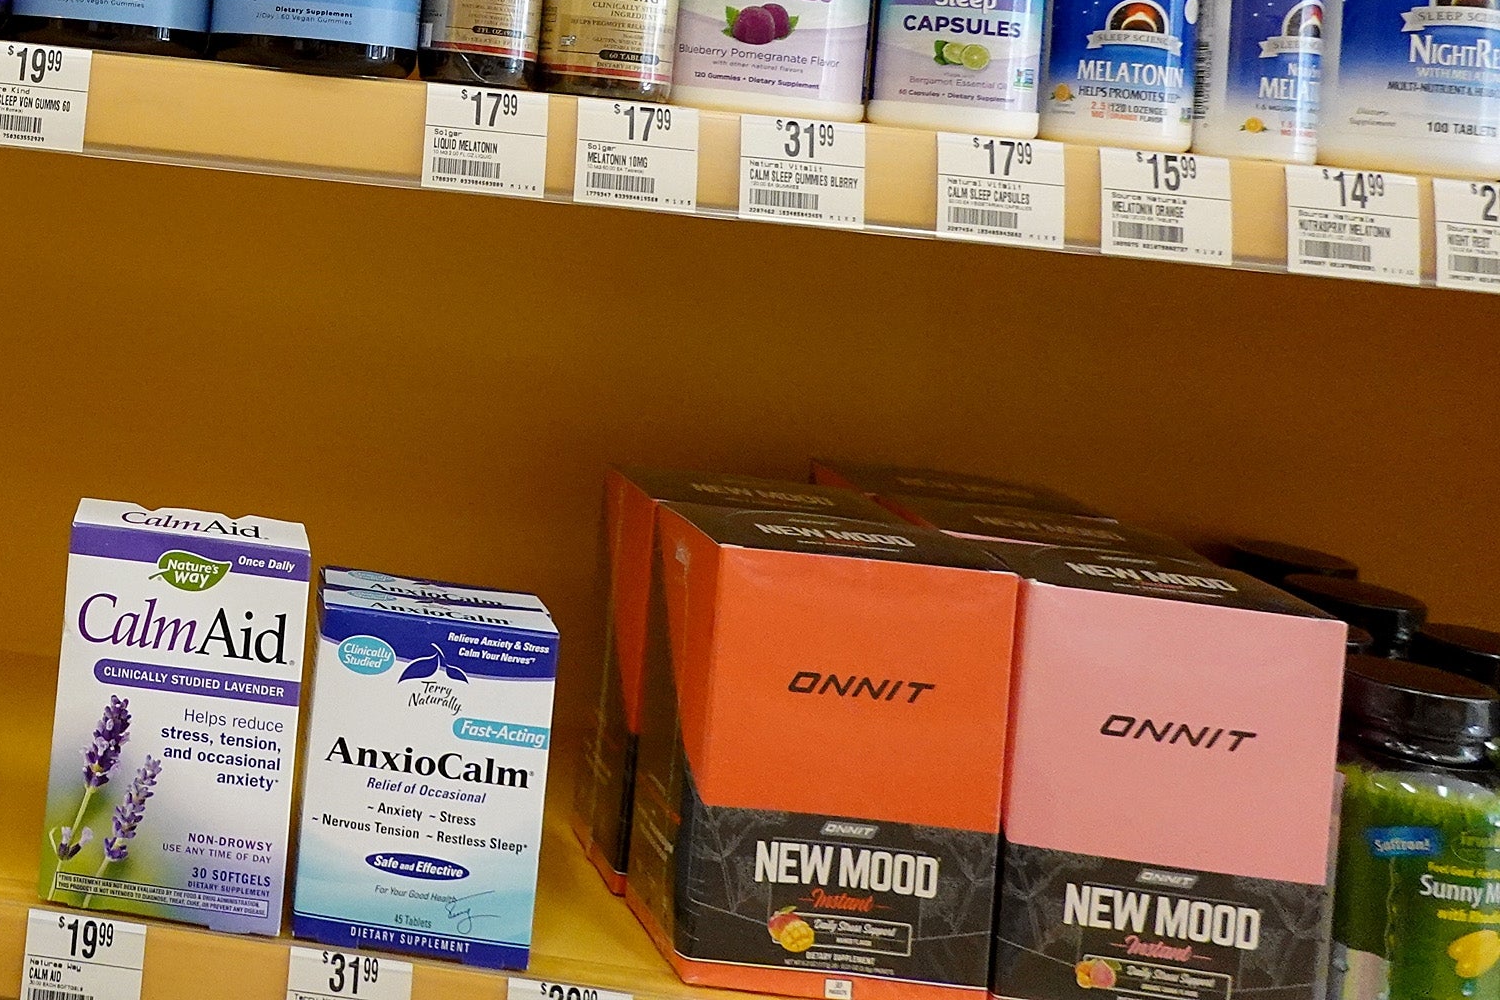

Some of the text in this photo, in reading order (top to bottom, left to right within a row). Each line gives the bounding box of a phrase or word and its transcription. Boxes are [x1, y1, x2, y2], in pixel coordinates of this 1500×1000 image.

[903, 15, 1021, 38] CAPSULES
[1077, 60, 1184, 88] MELATONIN
[19, 96, 33, 109] VGN
[35, 97, 59, 111] GUMMS
[62, 100, 71, 112] 60
[433, 137, 498, 154] LIQUID MELATONIN
[750, 169, 858, 189] CALM SLEEP GUMMIES BLBRRY
[167, 558, 219, 576] Nature's
[238, 555, 295, 573] Once Daily
[174, 569, 210, 588] Way
[77, 593, 288, 665] CalmAid
[342, 641, 392, 661] Clinically
[343, 655, 383, 669] Studied
[104, 666, 284, 697] CLINICALLY STUDIED LAVENDER
[787, 672, 934, 702] ONNIT
[184, 708, 284, 732] Helps reduce
[161, 727, 282, 752] stress, tension,
[460, 720, 546, 748] Fast-Acting
[1100, 714, 1256, 752] ONNIT
[163, 745, 280, 771] and occasional
[325, 737, 529, 788] AnxioCalm
[367, 777, 487, 804] Relief of Occasional
[192, 867, 271, 887] 30 SOFTGELS
[373, 855, 463, 878] Safe and Effective
[754, 840, 939, 898] NEW MOOD
